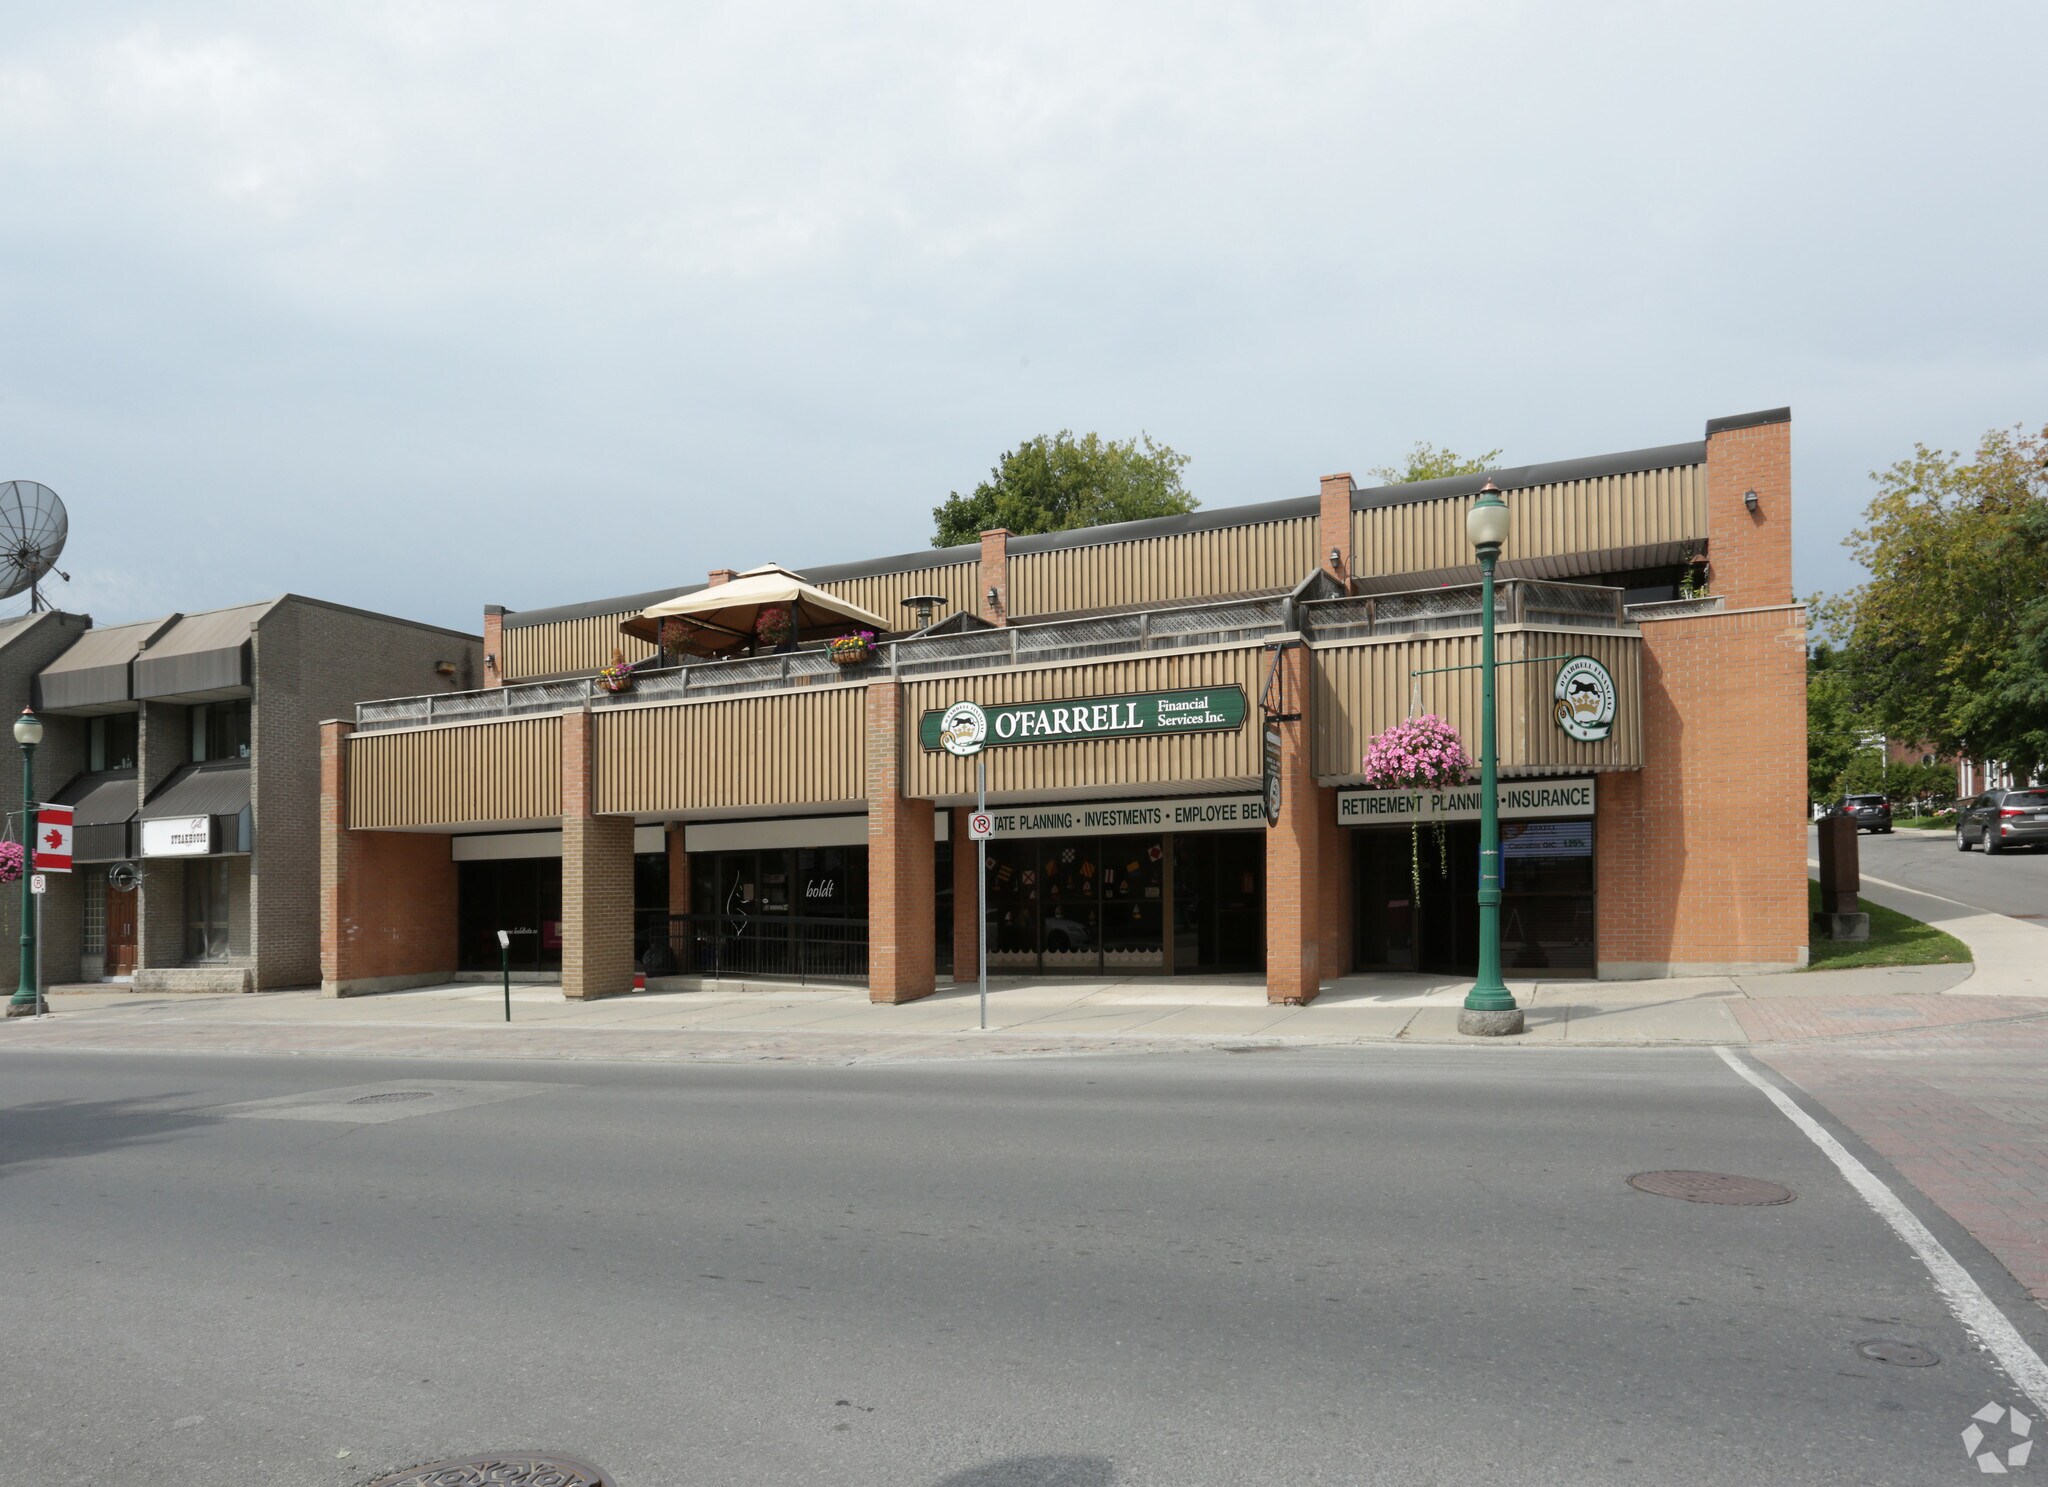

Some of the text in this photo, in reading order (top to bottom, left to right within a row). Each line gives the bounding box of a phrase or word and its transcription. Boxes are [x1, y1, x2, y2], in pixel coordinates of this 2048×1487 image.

[1158, 696, 1209, 712] Financial
[995, 702, 1144, 738] O'FARRELL
[1158, 711, 1226, 727] Services Inc.
[1342, 787, 1590, 816] RETIREMENT PLANNI INSURANCE
[994, 815, 1015, 831] TATE
[1020, 813, 1072, 830] PLANNING
[1084, 808, 1161, 827] INVESTMENTS
[1175, 804, 1237, 823] EMPLOYEE
[171, 833, 206, 844] STEAKHOUSE
[805, 879, 834, 898] boldt
